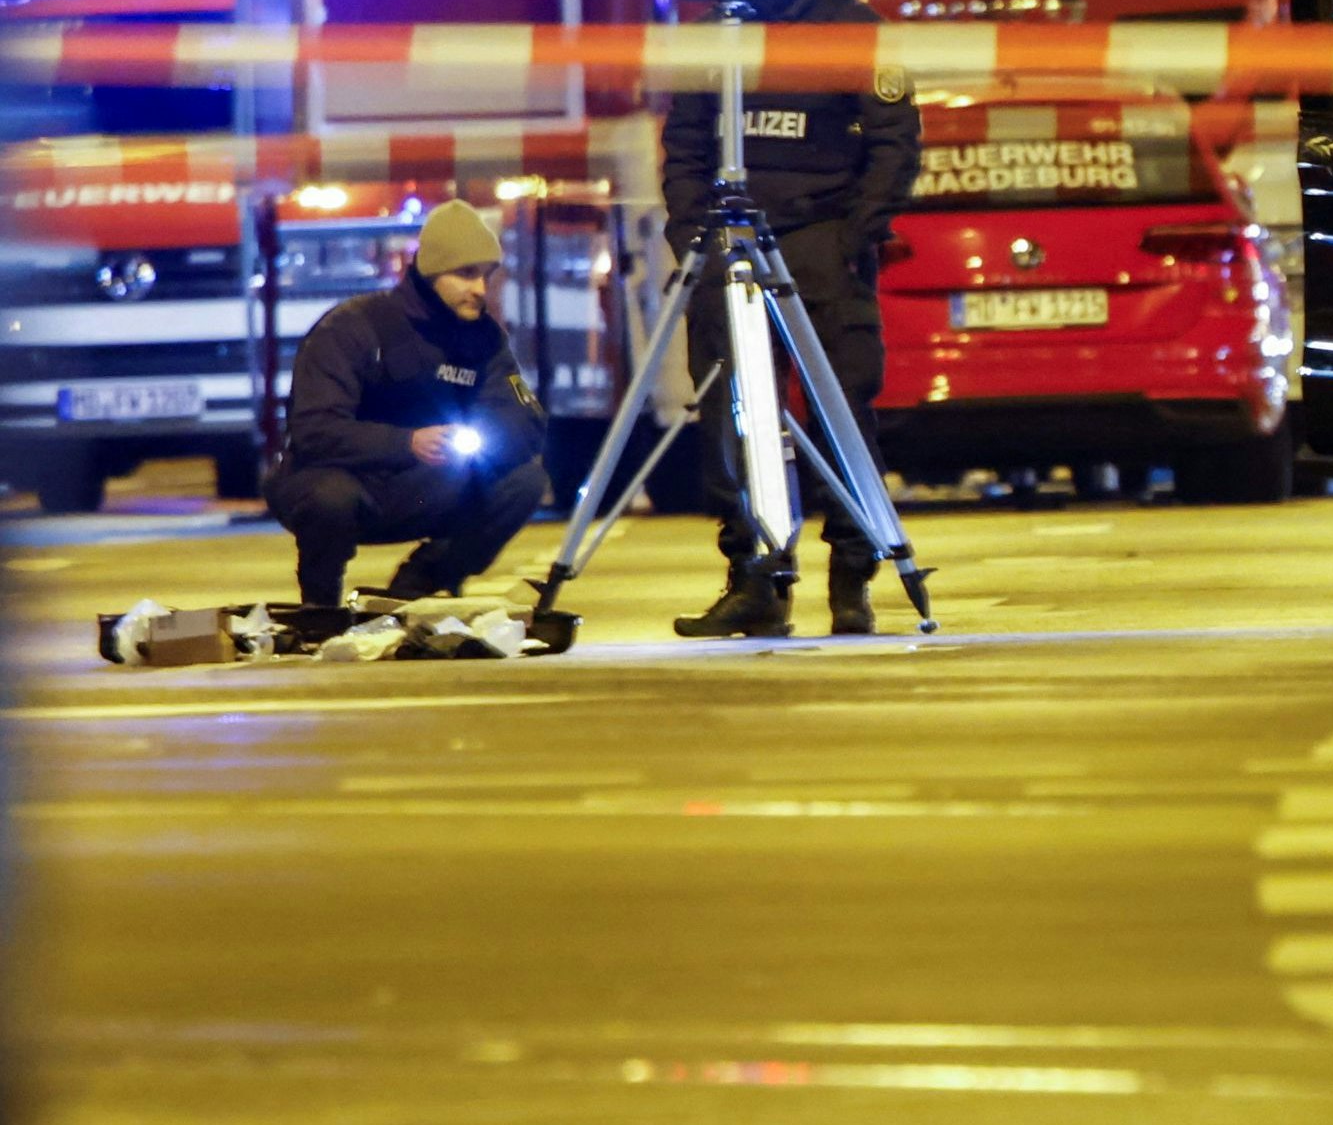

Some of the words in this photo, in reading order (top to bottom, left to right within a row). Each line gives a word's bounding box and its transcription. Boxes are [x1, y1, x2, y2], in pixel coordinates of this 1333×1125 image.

[719, 110, 807, 138] LIZEI
[921, 141, 1135, 172] EUERWEHR
[437, 363, 477, 386] POLIZEI
